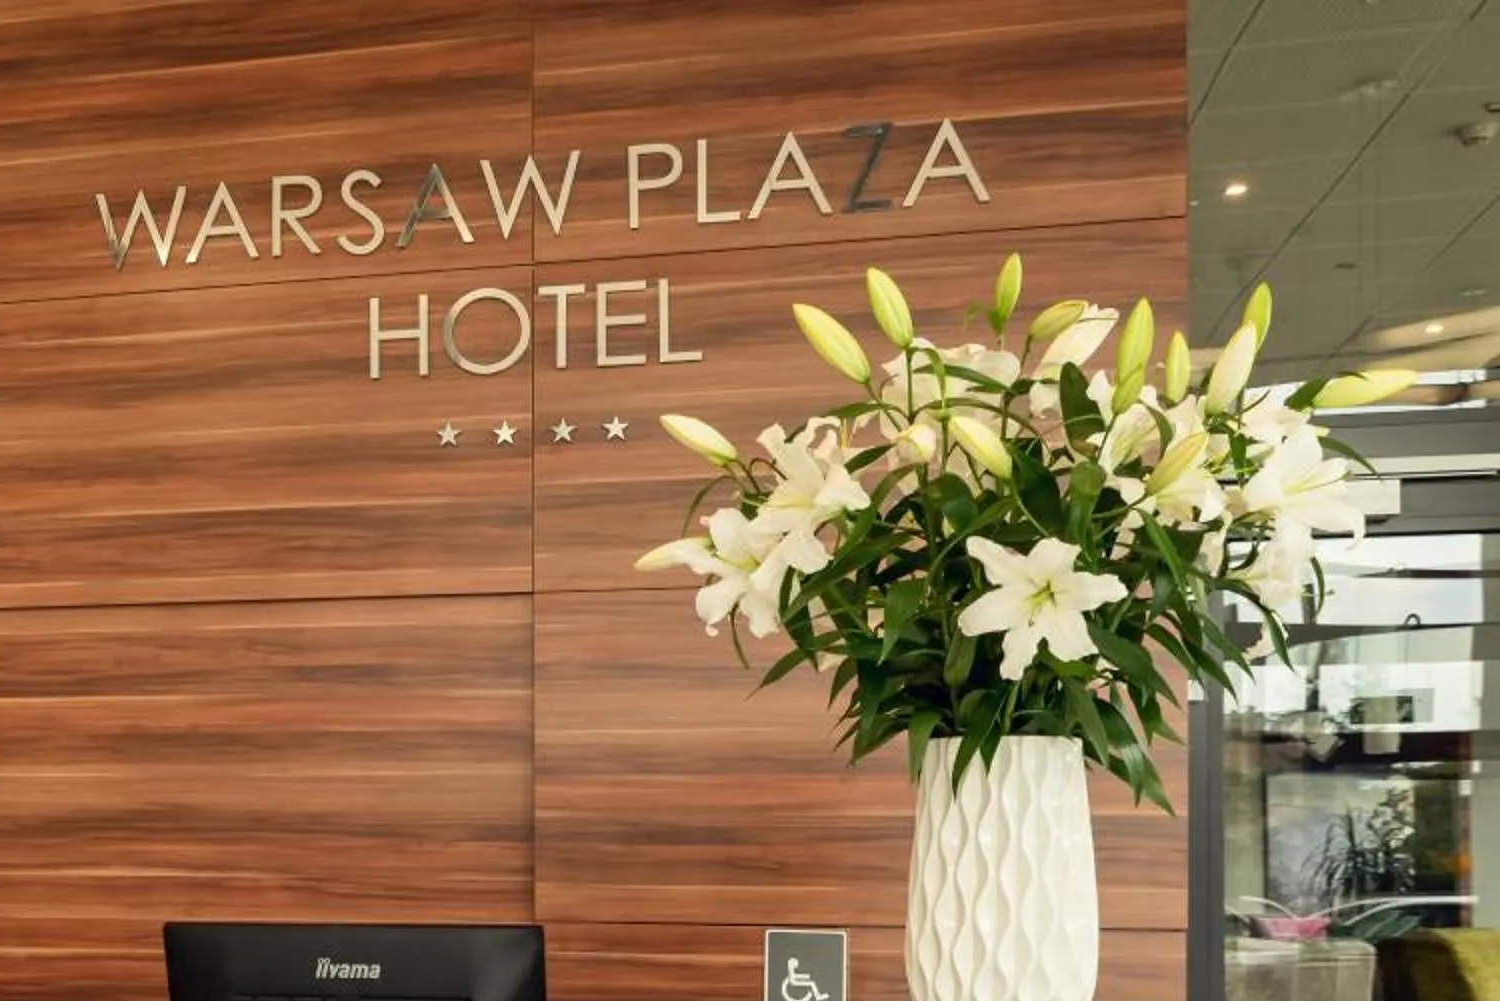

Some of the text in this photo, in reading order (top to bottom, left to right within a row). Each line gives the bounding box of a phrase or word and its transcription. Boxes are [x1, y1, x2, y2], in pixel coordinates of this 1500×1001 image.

[96, 117, 991, 271] WARSAW PLAZA
[368, 277, 703, 380] HOTEL
[315, 956, 381, 979] iiyama
